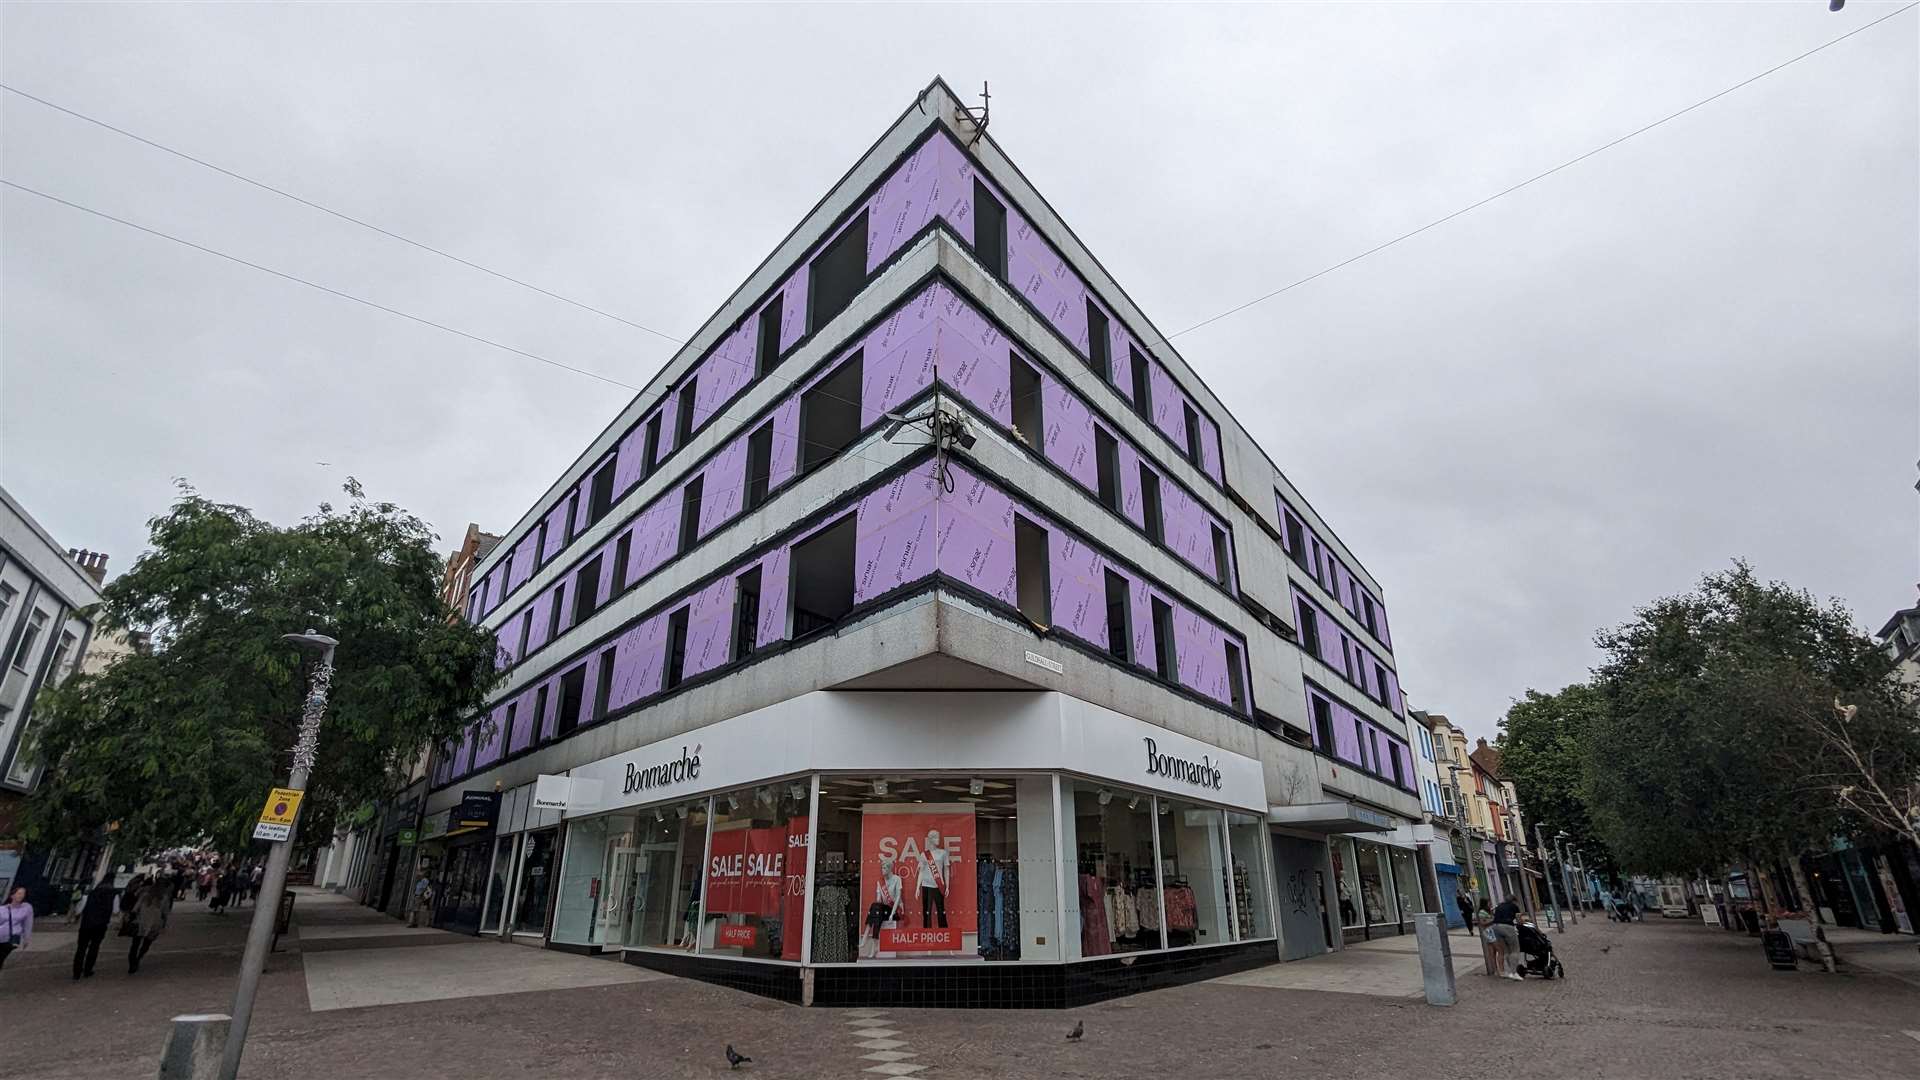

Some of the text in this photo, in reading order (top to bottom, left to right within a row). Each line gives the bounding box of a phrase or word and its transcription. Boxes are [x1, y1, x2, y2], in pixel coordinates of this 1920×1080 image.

[623, 744, 702, 794] Bonmarché
[1144, 737, 1222, 790] Bonmarché
[878, 836, 962, 862] SAE
[711, 854, 743, 877] SALE
[747, 854, 783, 877] SALE
[892, 932, 950, 943] HALF PRICE
